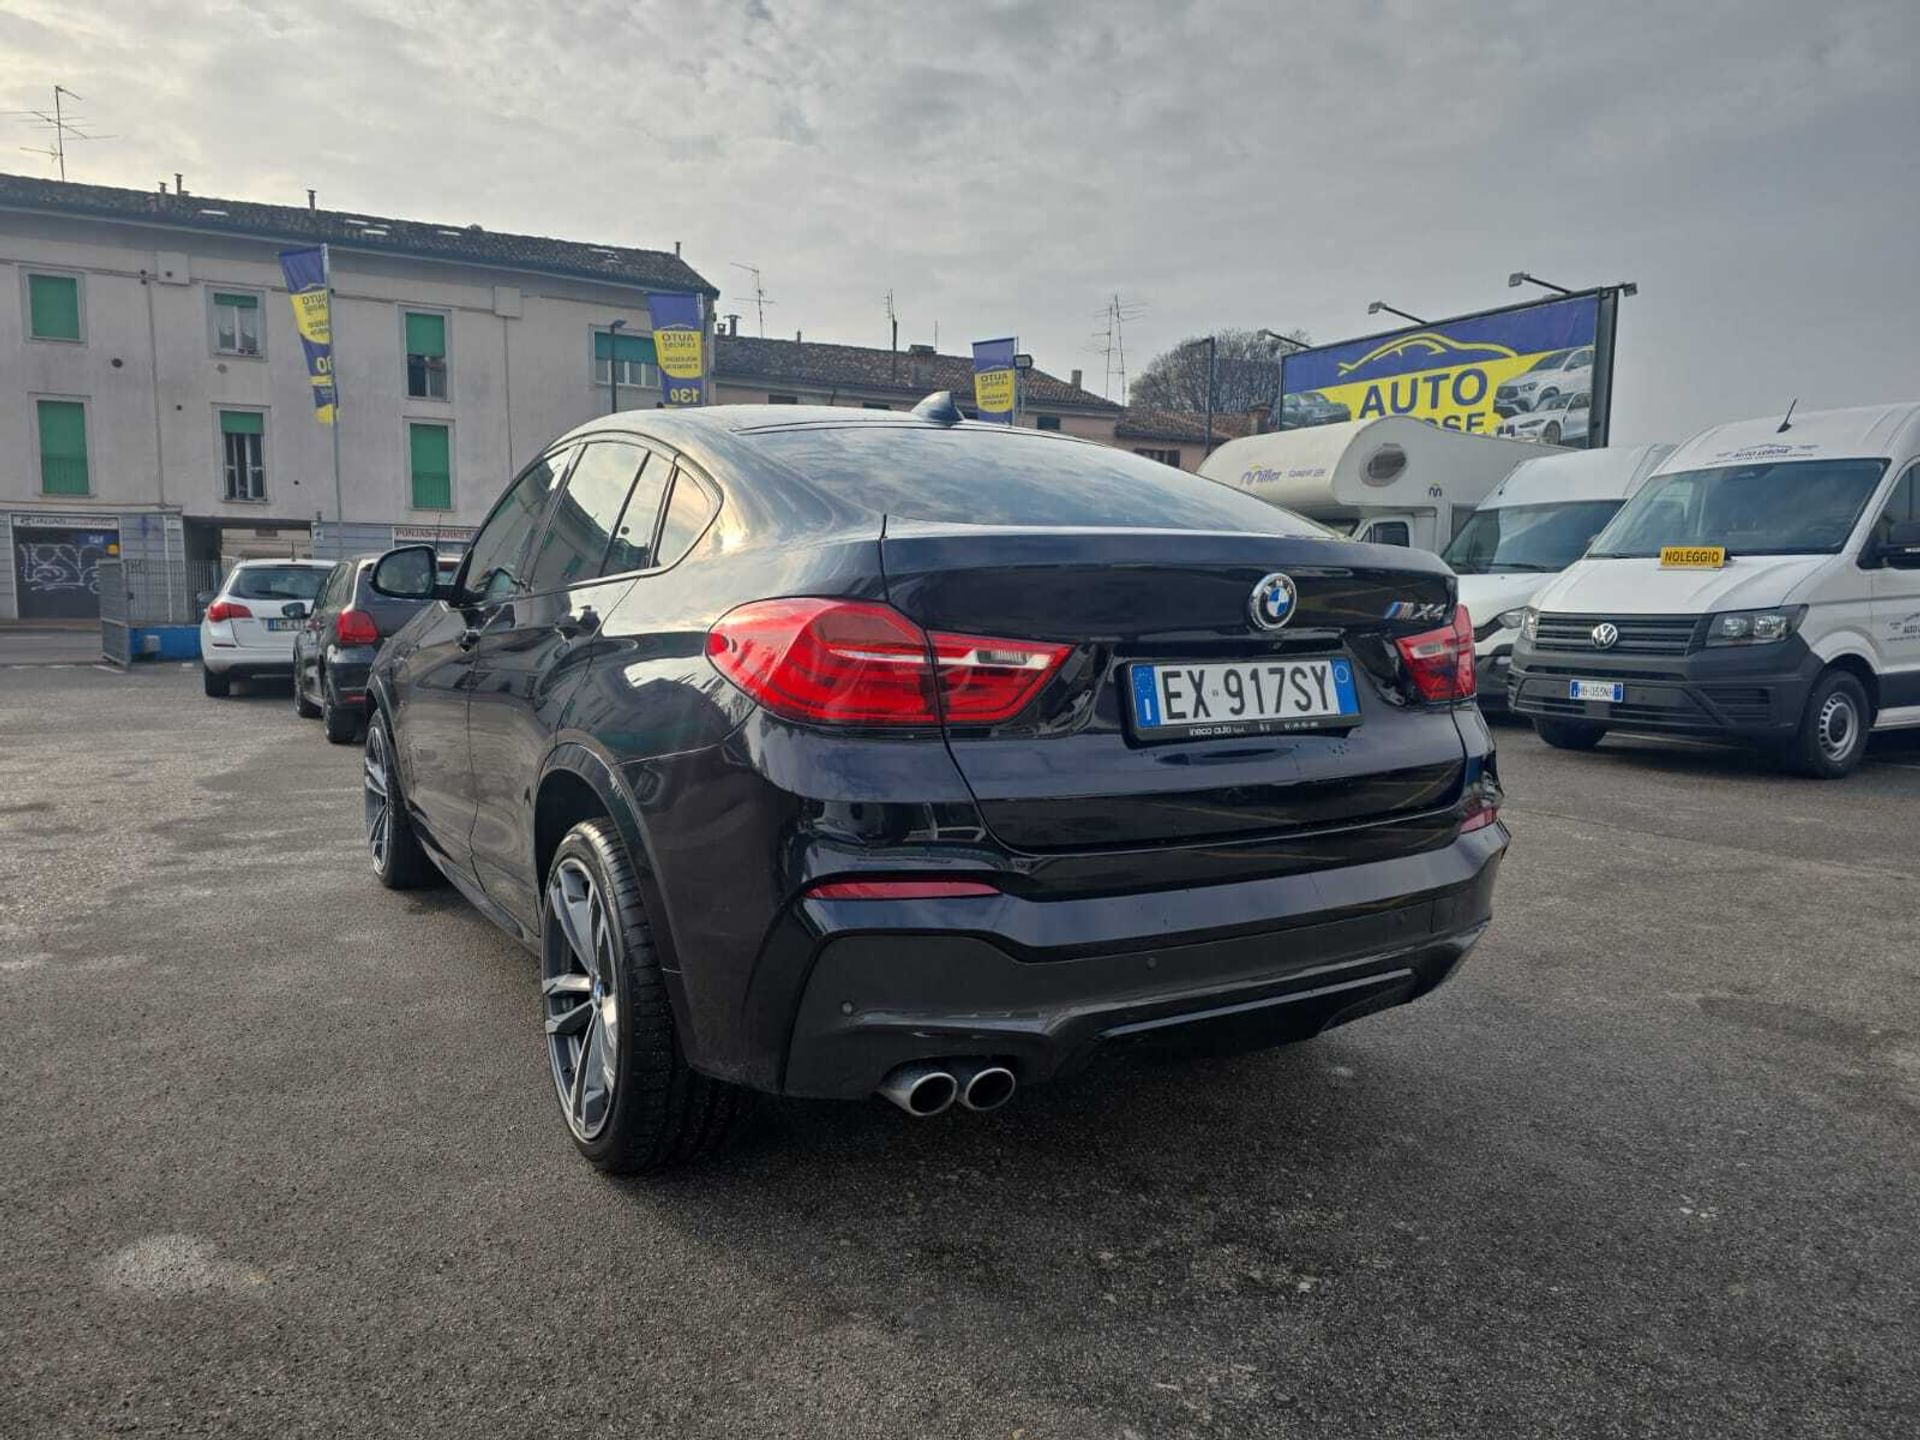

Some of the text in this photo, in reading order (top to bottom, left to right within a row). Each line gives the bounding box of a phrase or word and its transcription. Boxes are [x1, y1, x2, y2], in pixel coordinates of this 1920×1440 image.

[1359, 368, 1488, 419] AUTO
[1665, 550, 1720, 563] NOLEGGIO
[1411, 603, 1447, 620] X4
[1161, 669, 1211, 720] EX
[1223, 665, 1329, 716] 917SY
